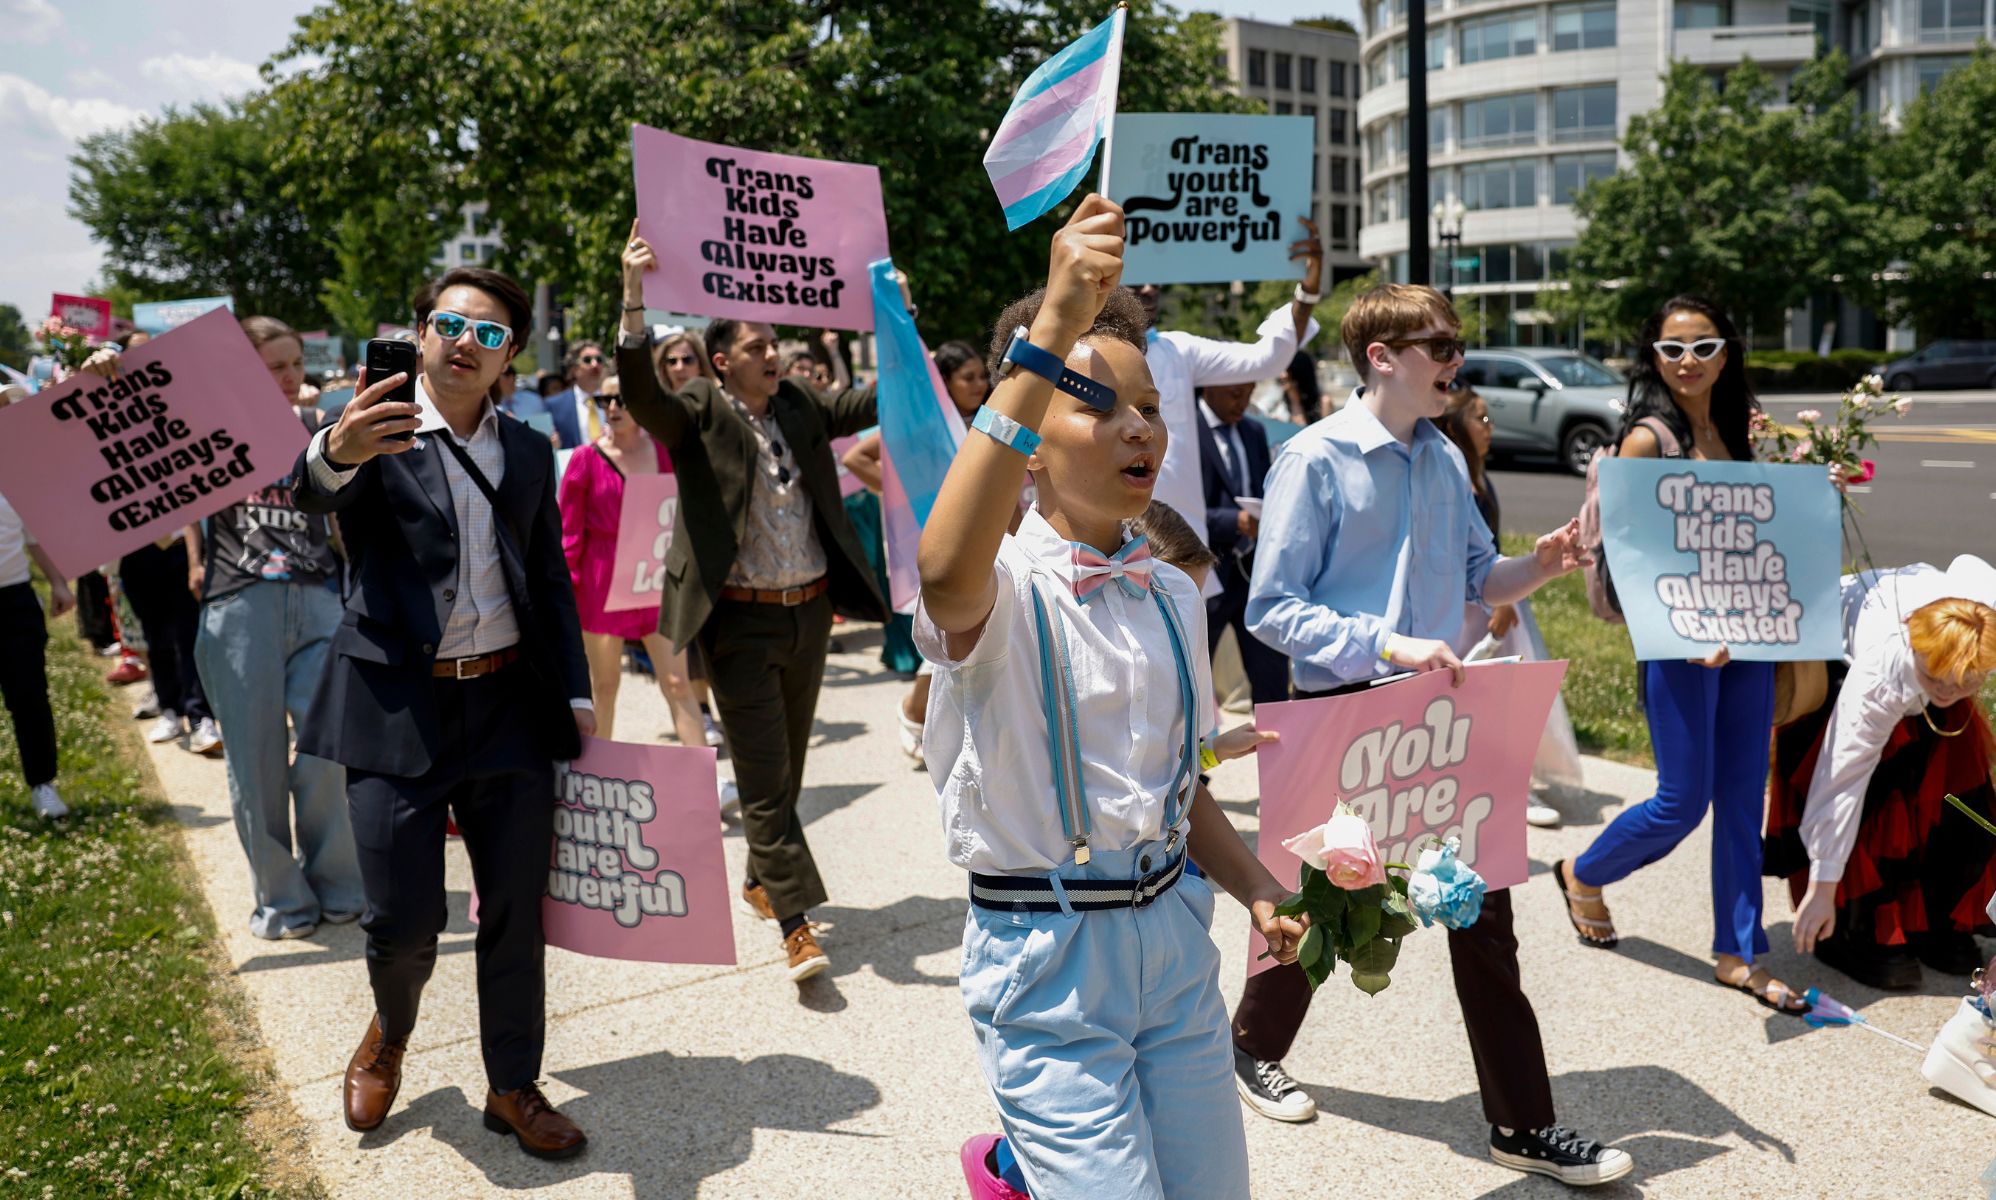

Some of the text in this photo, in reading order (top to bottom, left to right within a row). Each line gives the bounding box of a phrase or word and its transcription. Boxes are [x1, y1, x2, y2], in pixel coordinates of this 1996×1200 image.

[1171, 135, 1269, 170] Trans
[705, 157, 814, 199] Trans
[1123, 166, 1270, 214] youth
[725, 185, 800, 219] Kids
[1185, 195, 1239, 217] are
[723, 216, 808, 249] Have
[1122, 211, 1281, 252] Powerful
[701, 240, 836, 281] Always
[703, 272, 845, 309] Existed
[51, 361, 172, 421] Trans
[86, 394, 168, 440] Kids
[100, 415, 191, 470] Have
[90, 429, 234, 503] Always
[108, 443, 255, 532] Existed
[1658, 473, 1774, 521] Trans
[234, 505, 308, 533] KIDS
[1676, 511, 1755, 550] Kids
[1700, 542, 1785, 582] Have
[1656, 575, 1789, 617] Always
[1670, 602, 1801, 643] Existed
[1340, 698, 1471, 791] You
[552, 761, 655, 821] Trans
[553, 805, 657, 868] outh
[557, 840, 621, 877] are
[550, 871, 687, 926] werful
